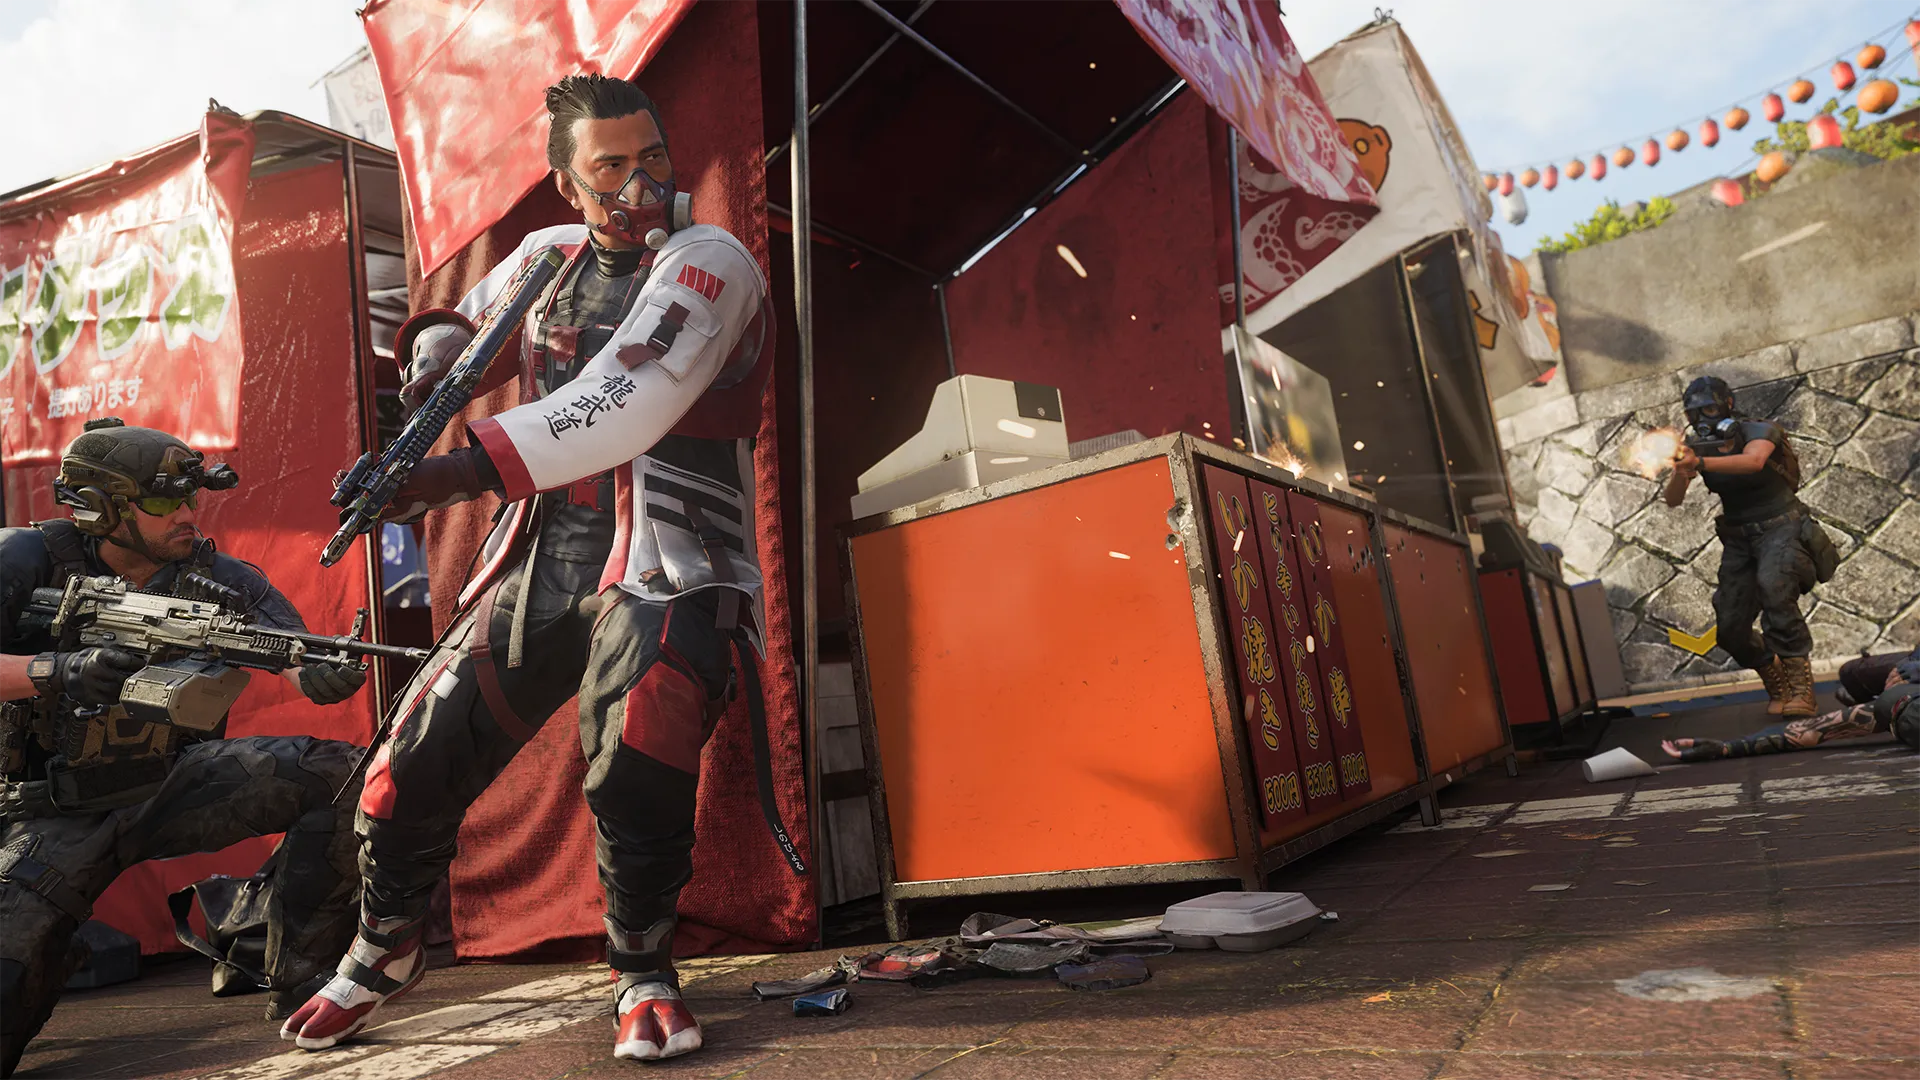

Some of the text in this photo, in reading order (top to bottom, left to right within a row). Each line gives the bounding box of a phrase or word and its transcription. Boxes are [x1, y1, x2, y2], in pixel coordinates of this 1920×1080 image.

[543, 374, 637, 441] 龍武道
[1217, 491, 1281, 750] いか焼き
[1264, 771, 1301, 814] 500円
